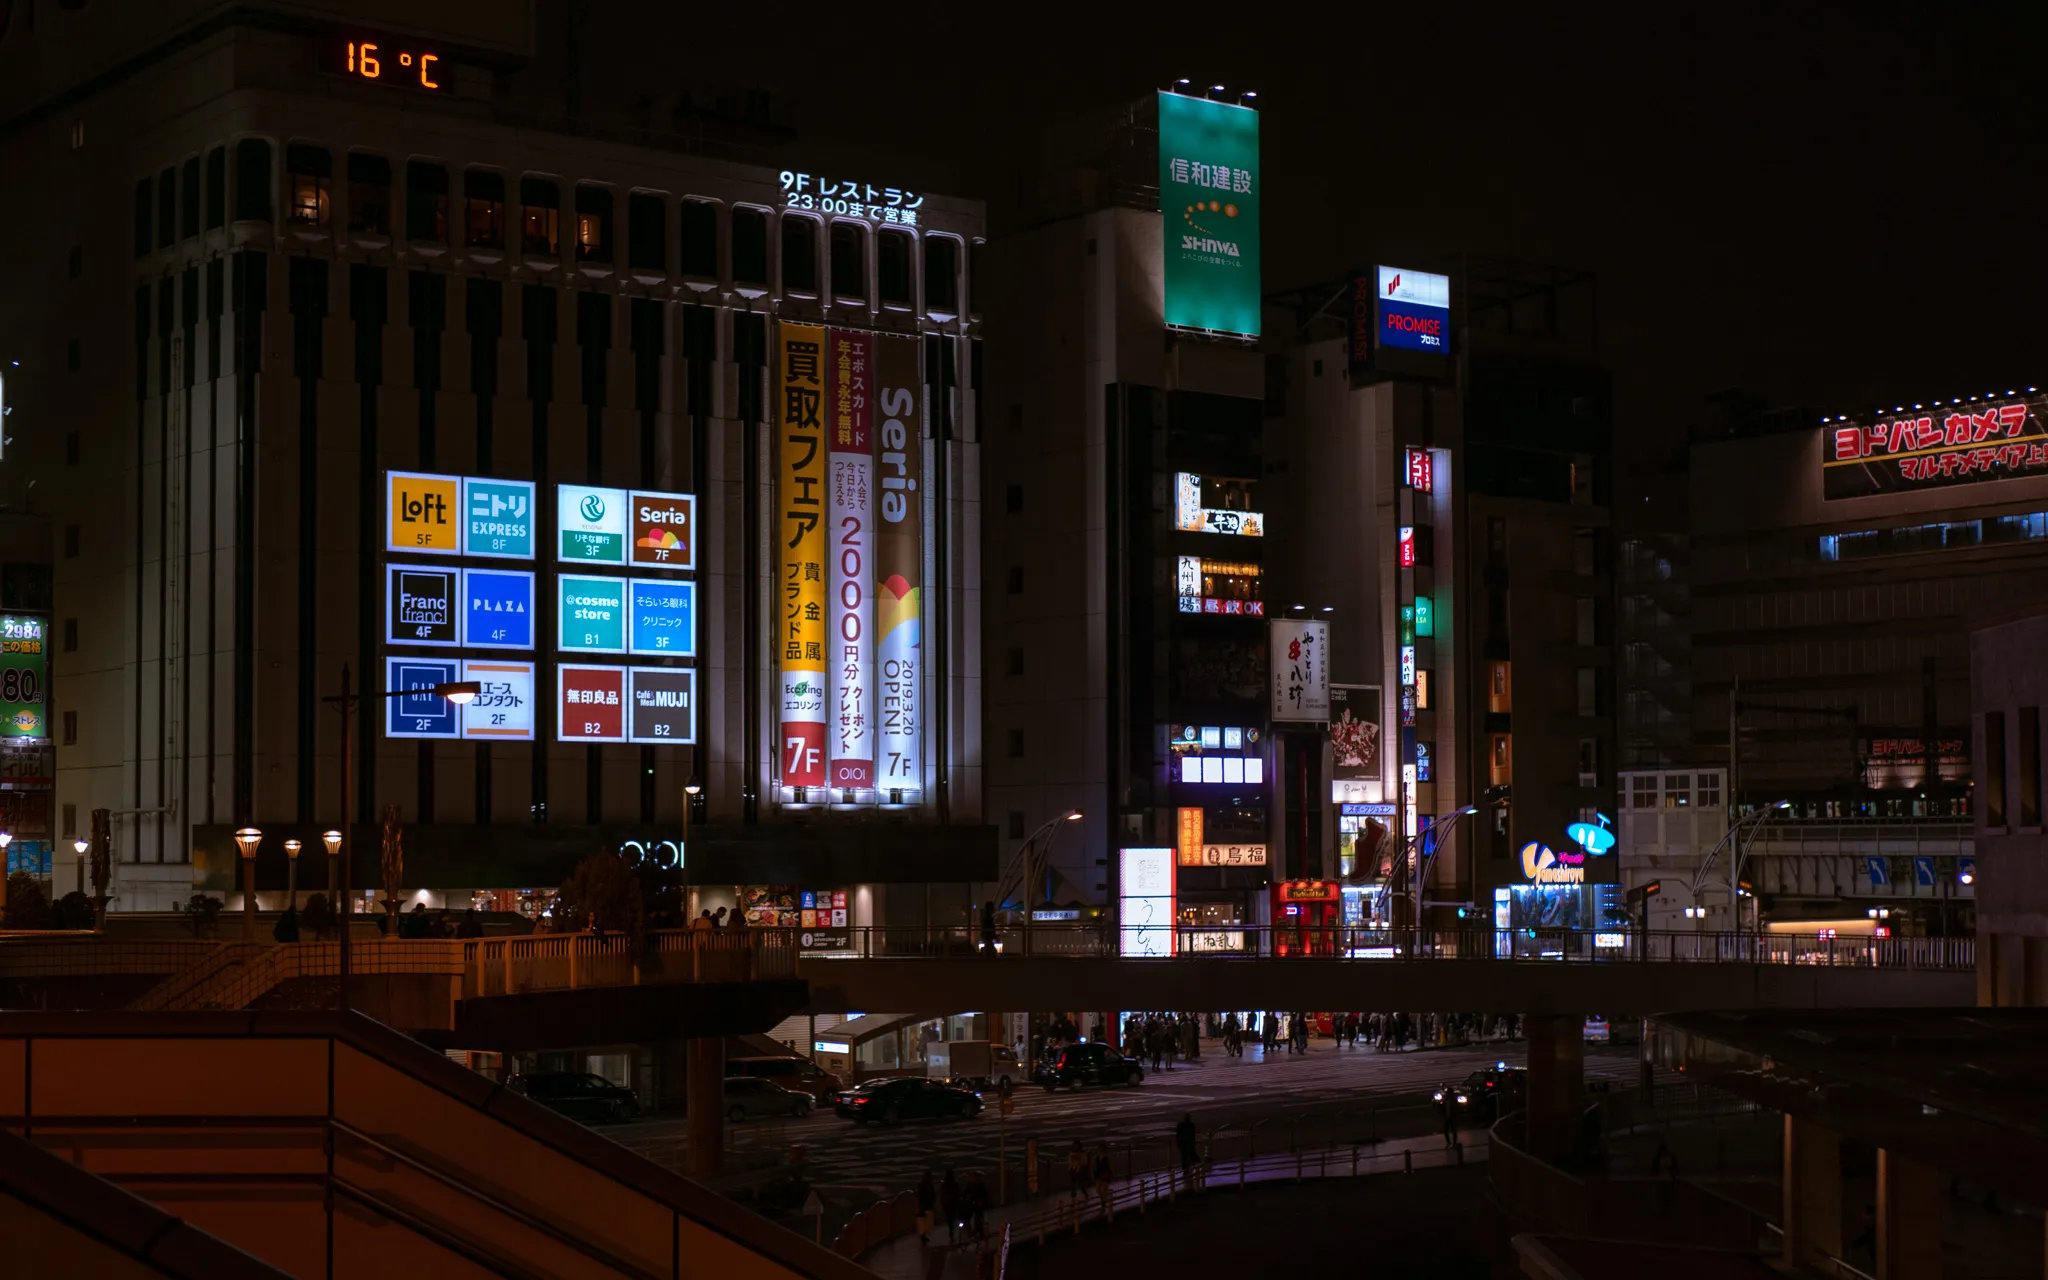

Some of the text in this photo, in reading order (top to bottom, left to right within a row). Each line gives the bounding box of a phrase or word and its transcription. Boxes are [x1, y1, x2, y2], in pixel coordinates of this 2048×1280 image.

[348, 42, 380, 78] 16
[1169, 157, 1252, 195] 信和建設
[779, 171, 924, 209] 9F レストラン
[787, 192, 917, 226] 23:00まで営業
[1354, 276, 1367, 362] PROMISE
[1387, 313, 1441, 336] PROMISE
[1420, 334, 1441, 346] プロミス
[837, 339, 852, 446] 年会費永年無料
[852, 342, 865, 447] エポスカード
[1835, 404, 2027, 461] ヨドバシカメラ
[785, 340, 821, 549] 買取フェア
[881, 387, 916, 523] Seria
[835, 461, 845, 507] つかえる
[846, 461, 856, 510] 今日から
[857, 462, 868, 511] ご入会で
[472, 493, 527, 518] ニトリ
[640, 506, 686, 525] Seria
[472, 521, 527, 537] EXPRESS
[416, 533, 433, 546] 5F
[491, 538, 507, 550] 8F
[574, 533, 610, 545] りそな銀行
[585, 545, 600, 556] 3F
[655, 549, 669, 561] 7F
[401, 592, 446, 611] Franc
[473, 598, 525, 613] PLAZA
[566, 595, 619, 608] @cosme
[636, 596, 688, 609] そらいろ眼科
[405, 609, 443, 623] franc
[574, 607, 611, 621] store
[786, 561, 802, 660] ブランド品
[804, 561, 822, 661] 貴金属
[642, 616, 682, 628] クリニック
[416, 626, 432, 638] 4F
[491, 630, 506, 641] 4F
[585, 634, 599, 645] B1
[655, 636, 669, 648] 3F
[1302, 631, 1315, 684] やきとり
[484, 682, 512, 695] エース
[567, 688, 619, 706] 無印良品
[884, 659, 901, 735] OPEN!
[472, 694, 523, 708] コンタクト
[640, 699, 655, 707] Meal
[656, 691, 688, 708] MUJI
[785, 700, 822, 711] エコリング
[902, 660, 914, 736] 2019.3.20
[13, 715, 41, 726] ストレス
[491, 714, 506, 725] 2F
[839, 685, 852, 754] プレゼント
[853, 685, 865, 740] クーポン
[416, 719, 432, 731] 2F
[585, 723, 601, 735] B2
[655, 724, 670, 736] B2
[787, 736, 820, 774] 7F
[888, 752, 912, 777] 7F
[1348, 804, 1391, 815] スポーツジュエン
[1522, 843, 1584, 886] Yamashiroya
